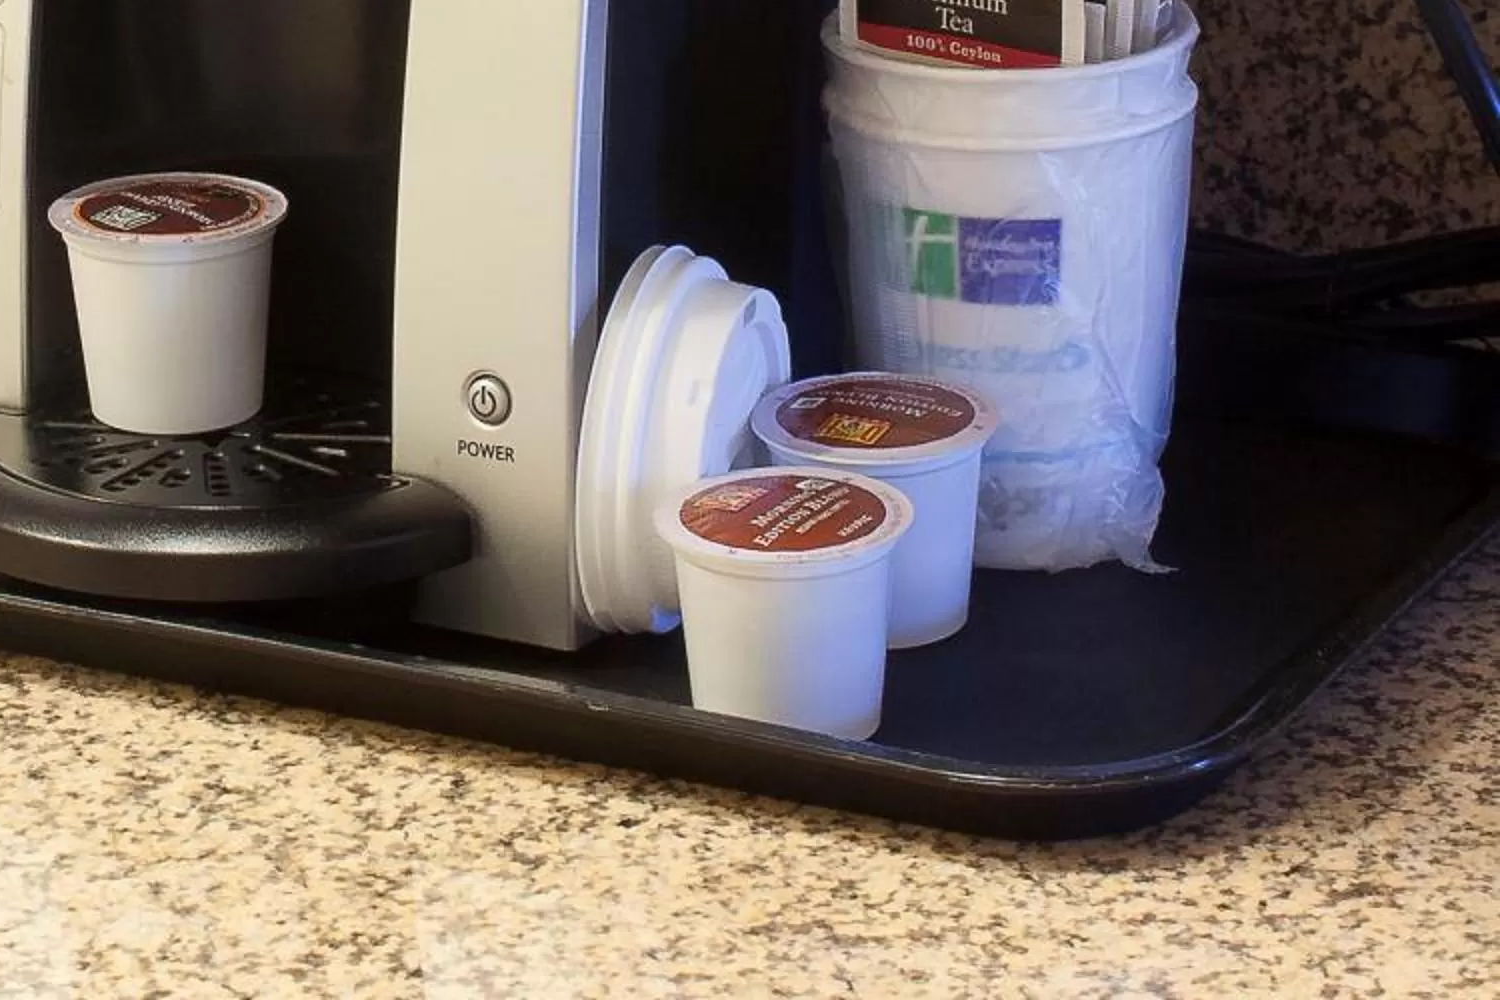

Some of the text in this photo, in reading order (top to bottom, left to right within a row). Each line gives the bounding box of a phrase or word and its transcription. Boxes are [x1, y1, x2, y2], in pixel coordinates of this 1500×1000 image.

[935, 6, 974, 34] Tea
[949, 41, 1002, 62] Ceylon
[457, 439, 515, 463] POWER
